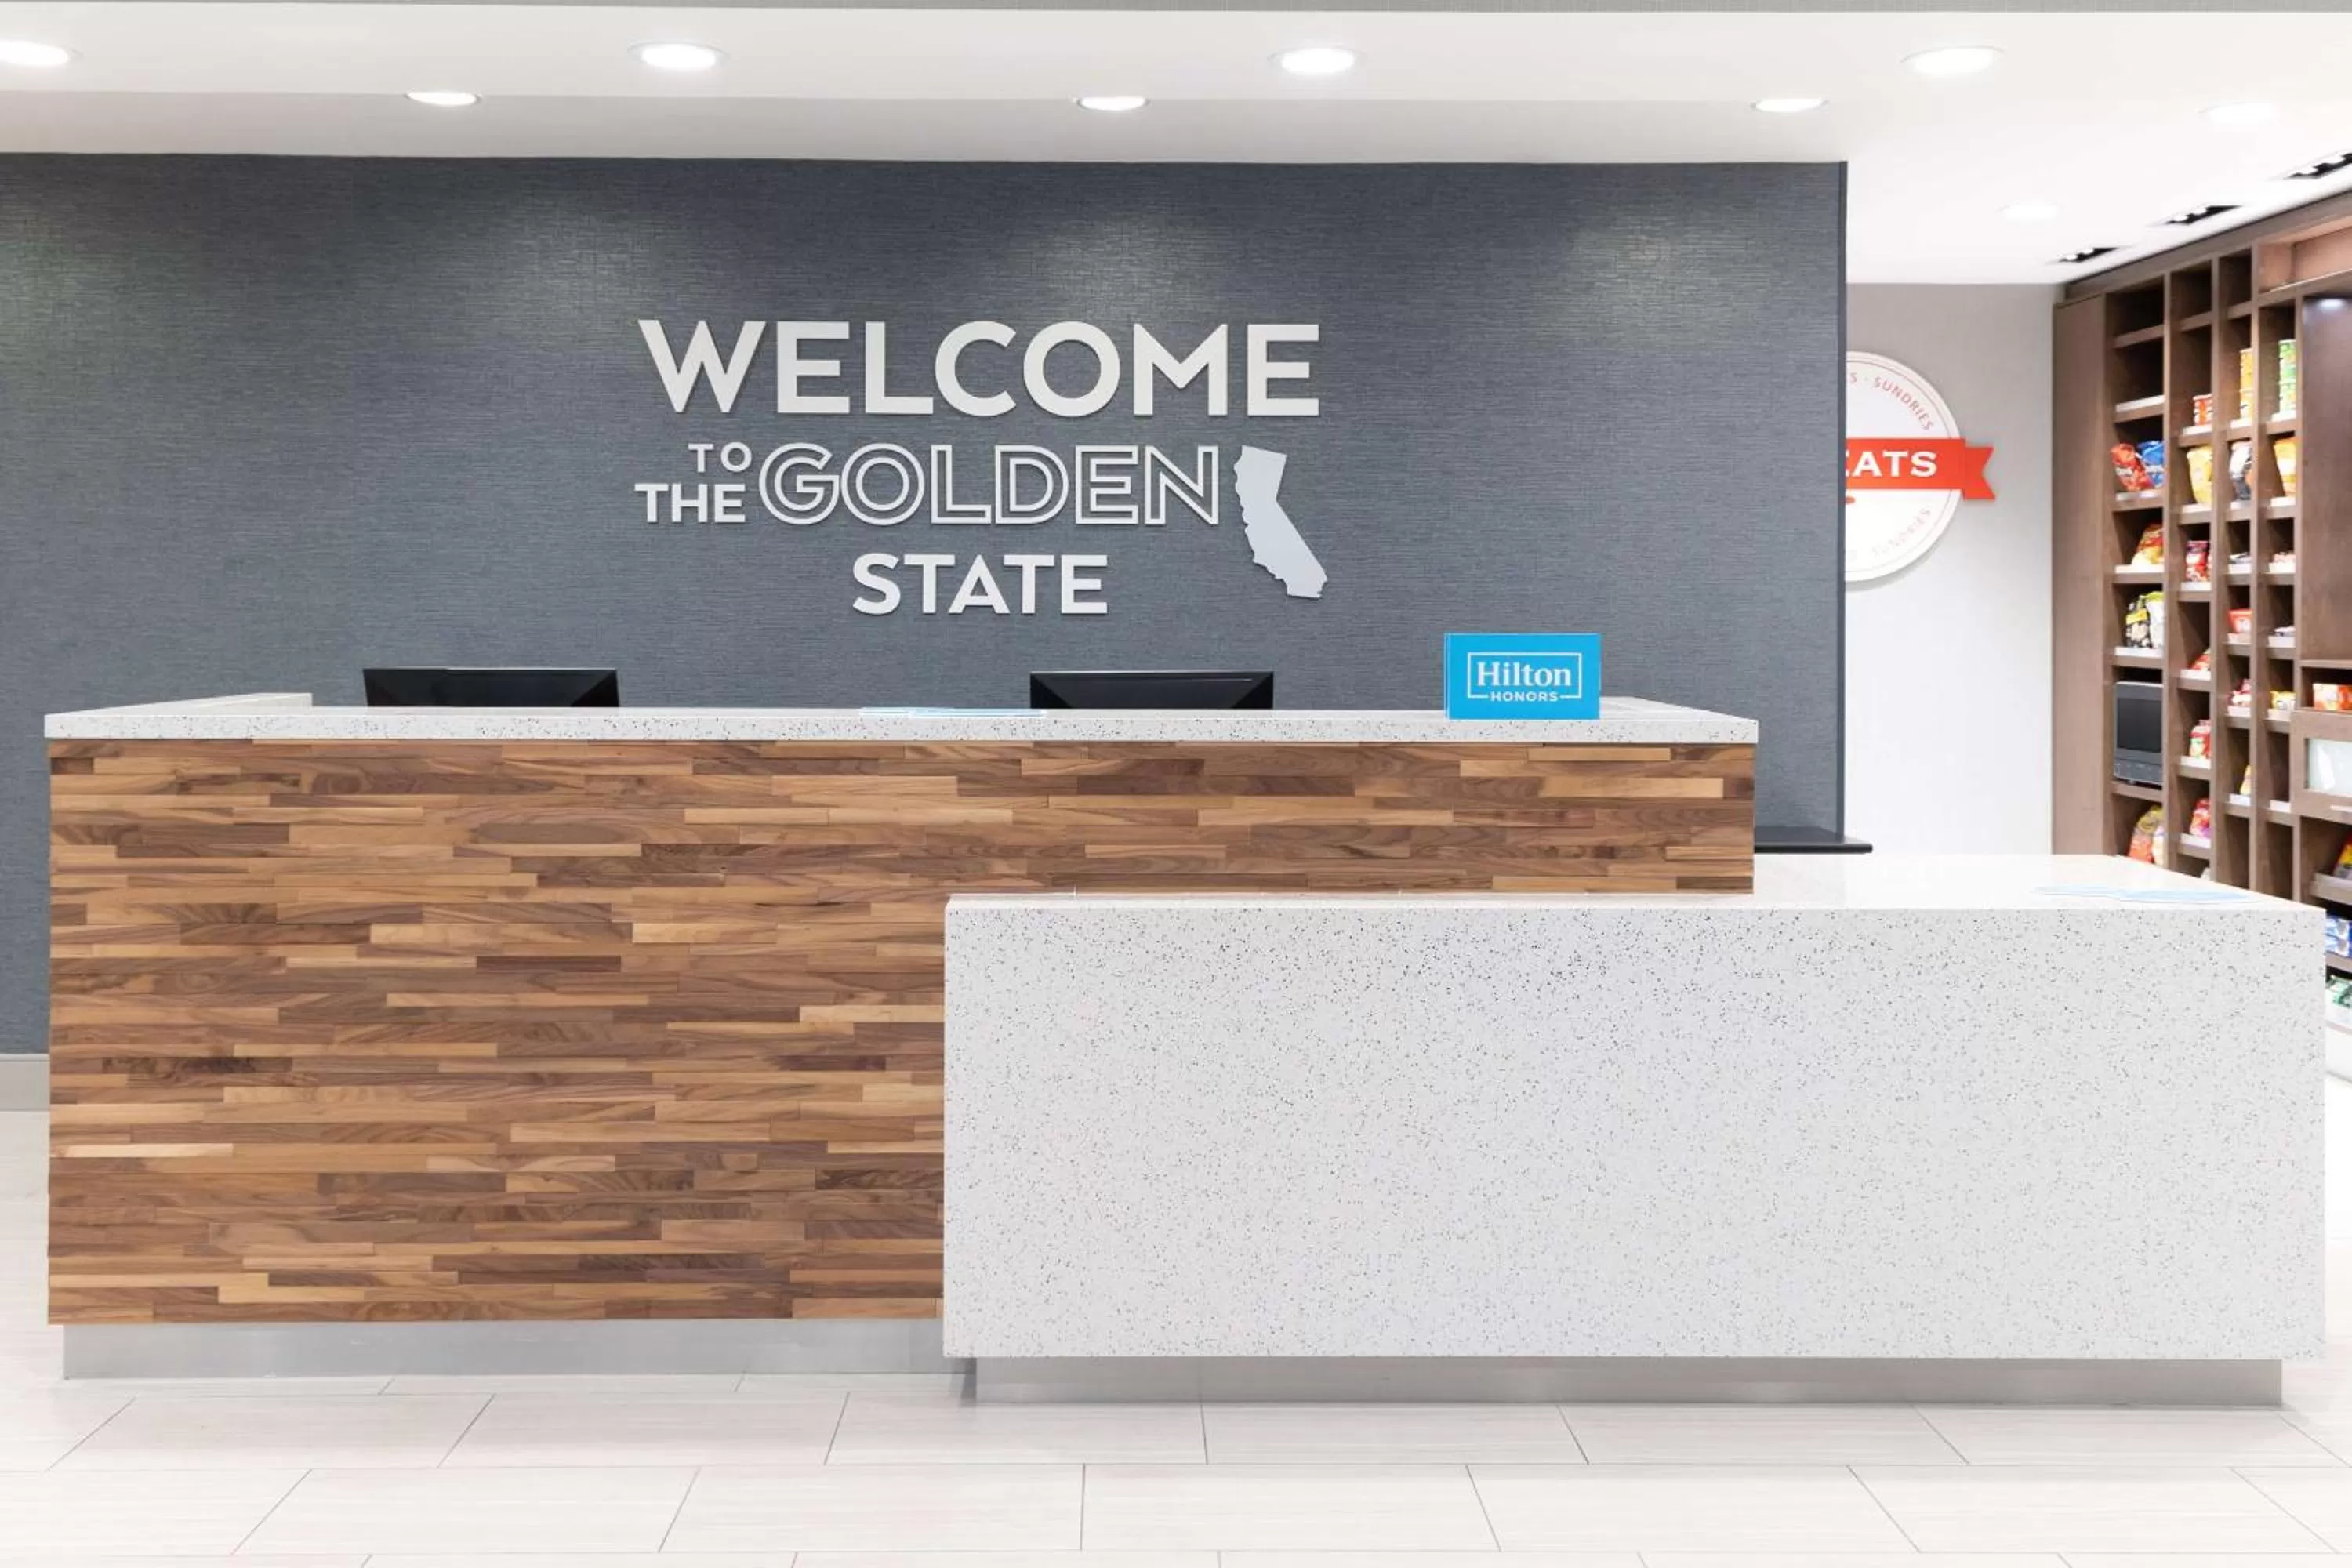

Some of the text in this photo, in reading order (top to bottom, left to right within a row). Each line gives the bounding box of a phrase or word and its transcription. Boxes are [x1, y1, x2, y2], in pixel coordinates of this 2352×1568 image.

[638, 319, 1319, 416] WELCOME
[1873, 376, 1935, 430] SUNDRIES
[688, 441, 752, 473] TO
[1845, 449, 1937, 477] ATS
[634, 442, 1218, 525] THE GOLDEN
[852, 553, 1108, 614] STATE
[1477, 662, 1572, 686] Hilton
[1490, 691, 1559, 702] HONORS
